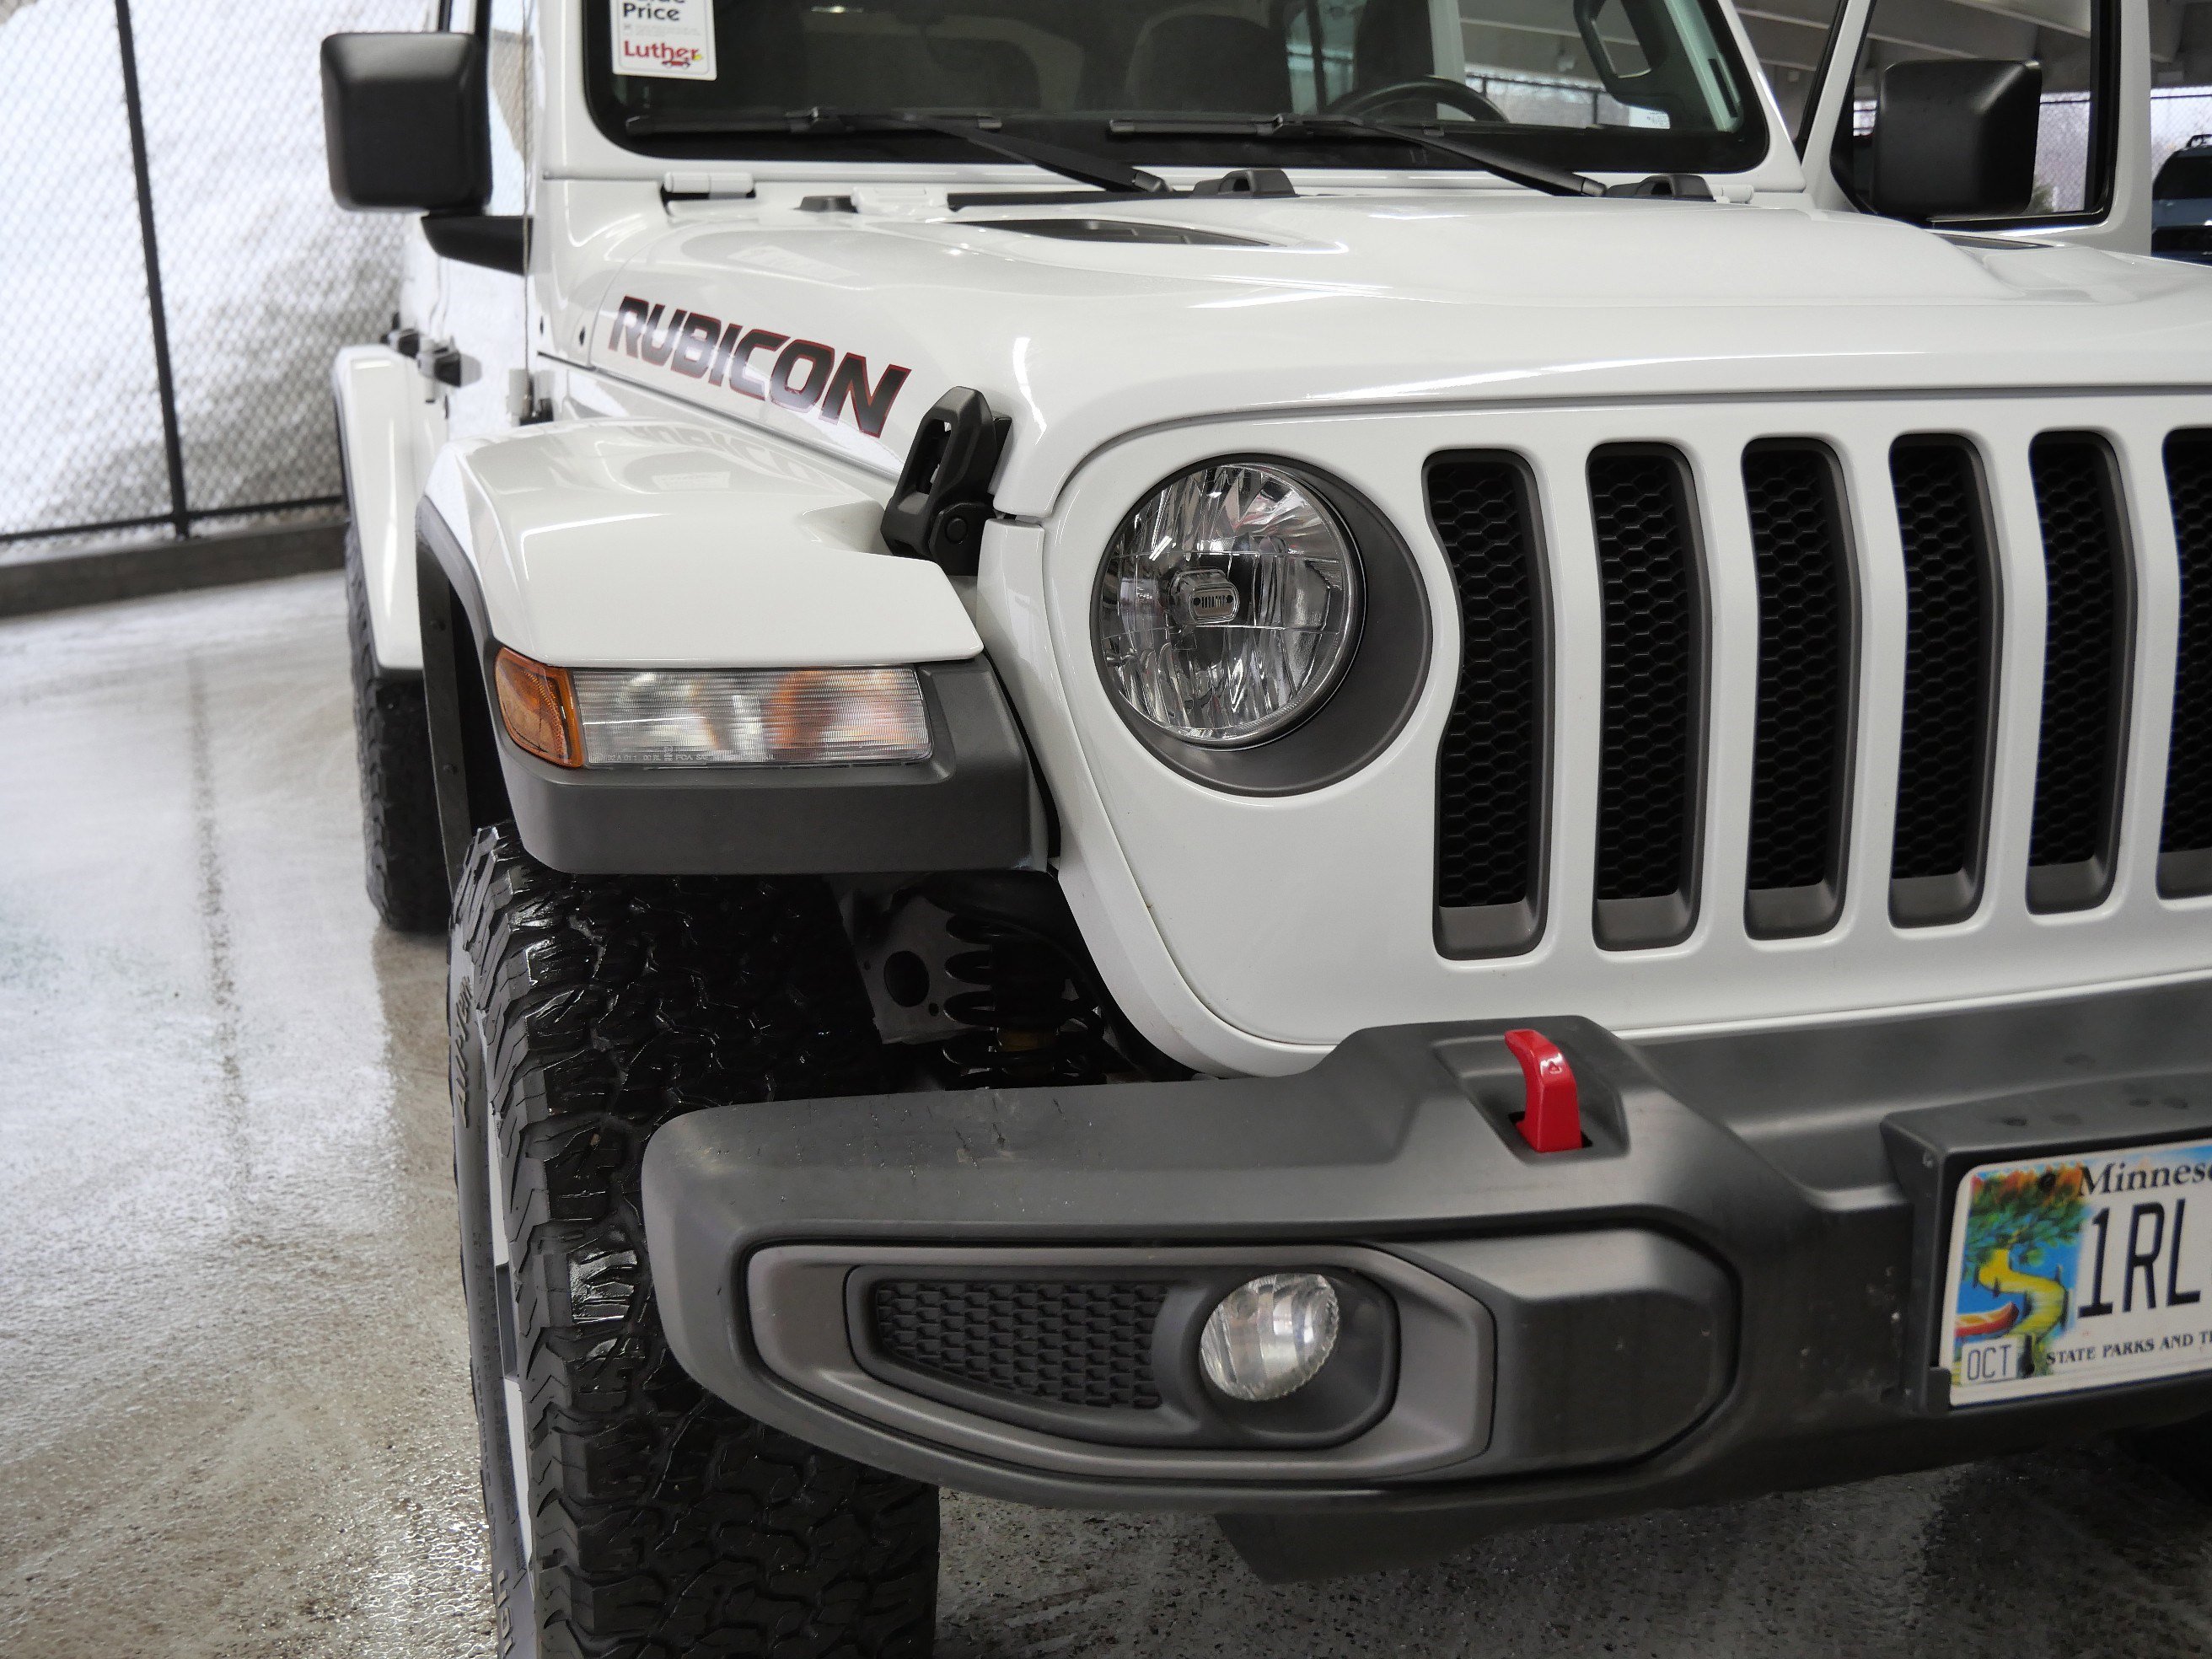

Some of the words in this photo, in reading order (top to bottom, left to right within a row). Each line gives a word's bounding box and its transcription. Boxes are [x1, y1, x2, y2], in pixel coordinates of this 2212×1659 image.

[623, 3, 679, 21] Price
[624, 40, 699, 61] Luther
[608, 295, 912, 438] RUBICON
[2077, 1198, 2201, 1318] 1RL
[1968, 1344, 2011, 1381] OCT
[2046, 1346, 2097, 1365] STATE
[2102, 1338, 2156, 1359] PARKS
[2160, 1333, 2194, 1351] AND
